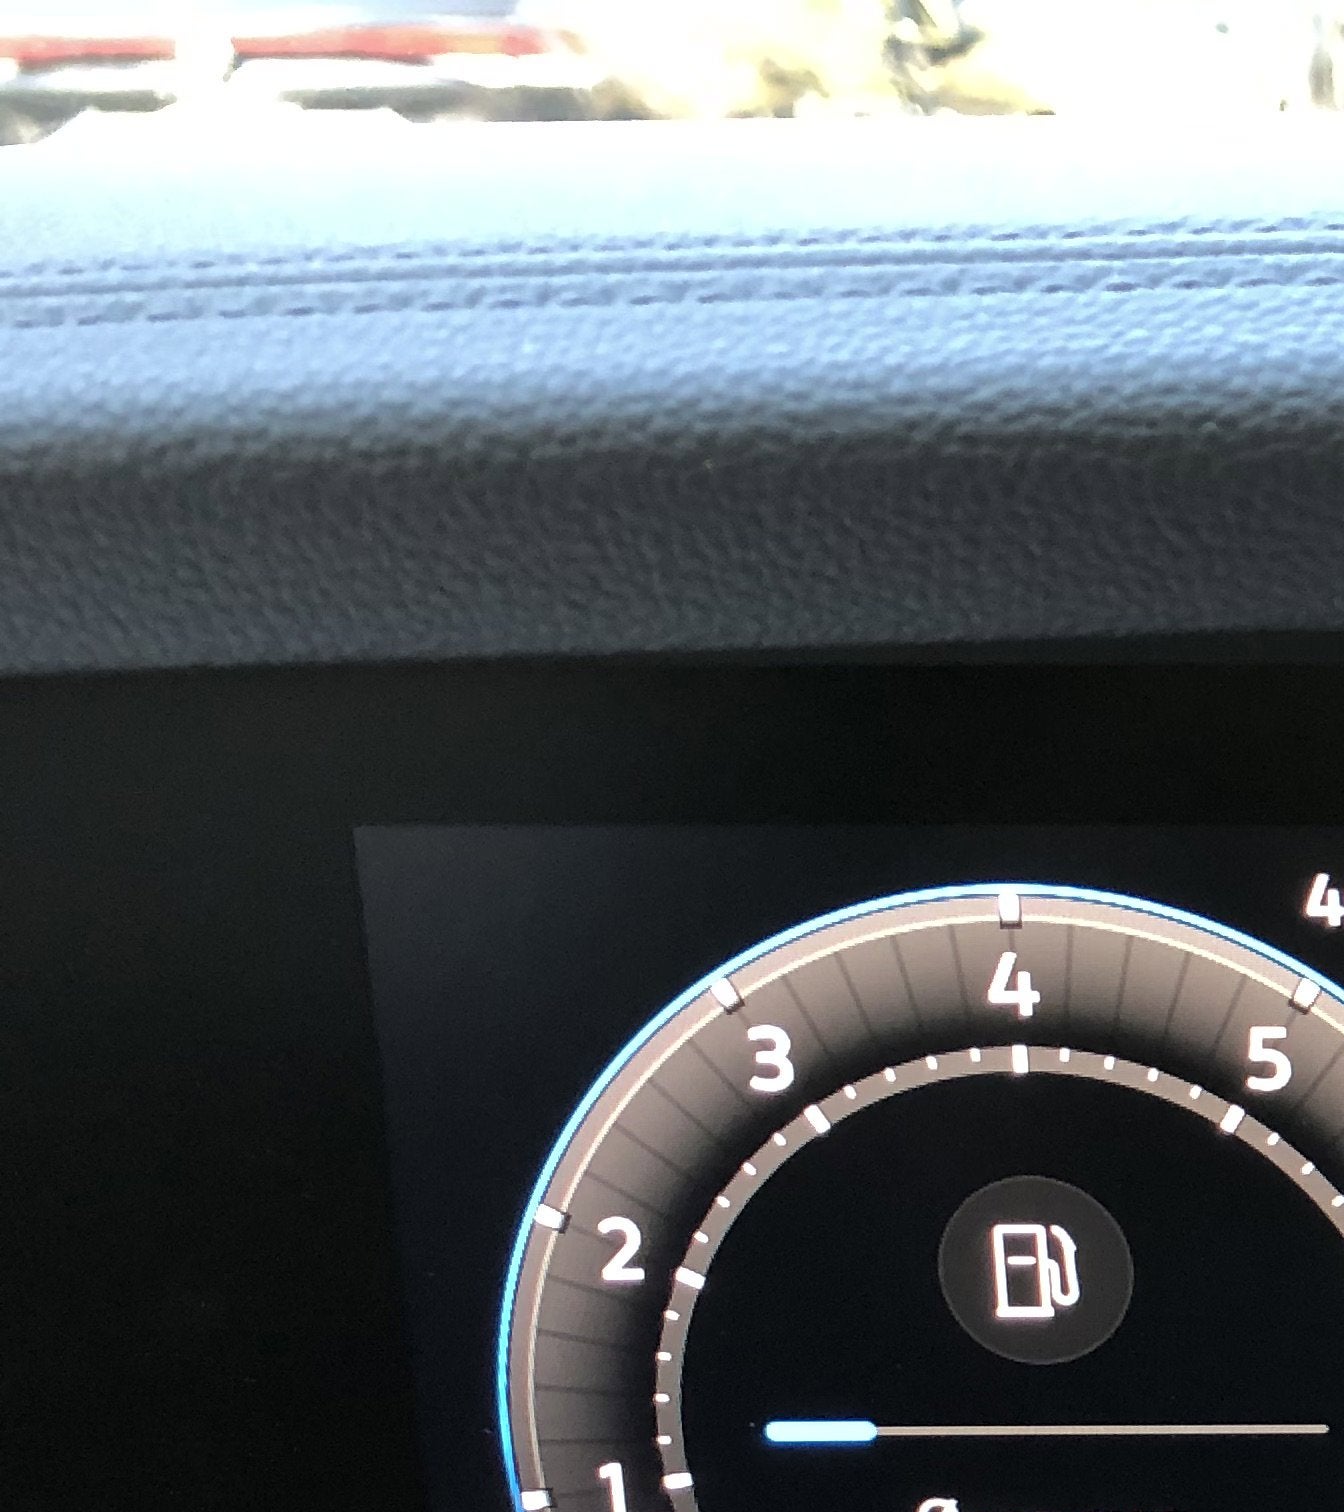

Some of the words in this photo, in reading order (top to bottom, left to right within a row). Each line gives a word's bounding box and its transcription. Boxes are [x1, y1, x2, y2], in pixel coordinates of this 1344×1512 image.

[988, 952, 1040, 1016] 4
[747, 1025, 794, 1092] 3
[1246, 1026, 1292, 1091] 5
[597, 1217, 645, 1281] 2
